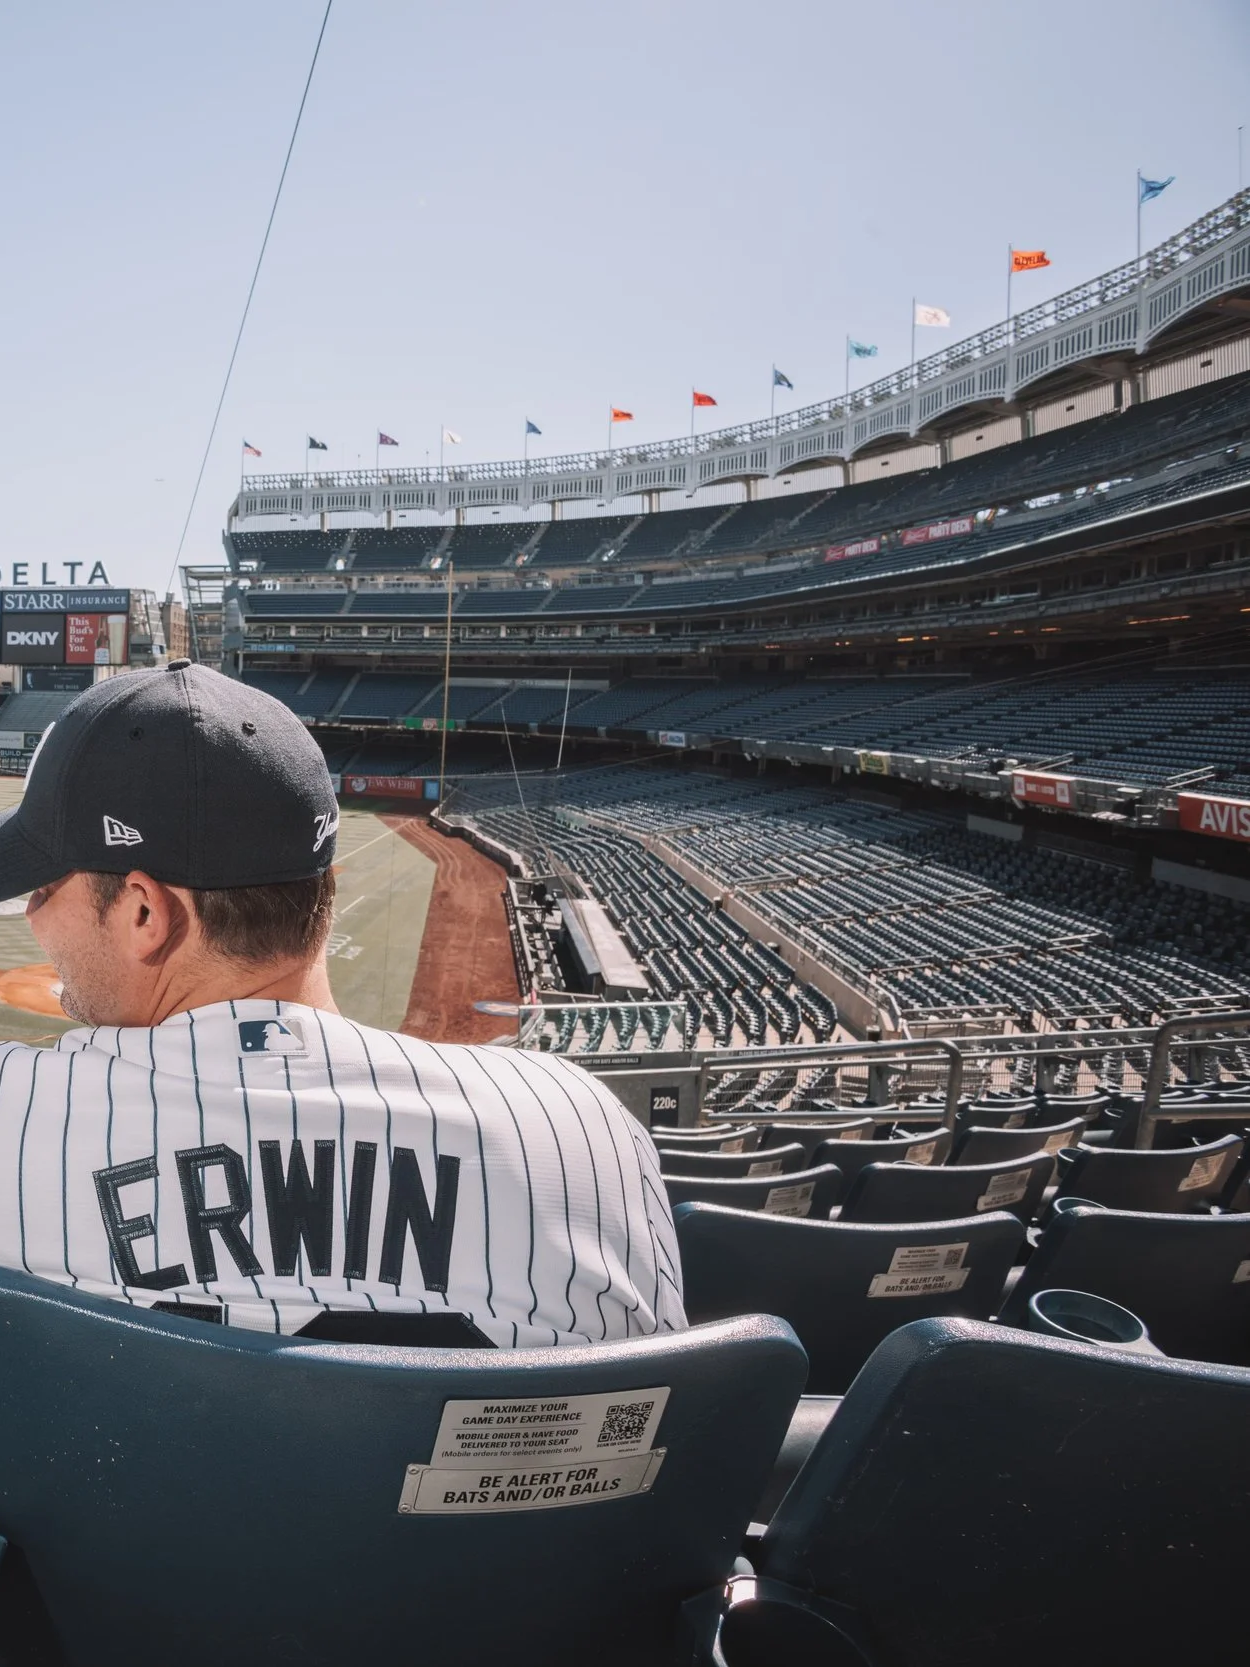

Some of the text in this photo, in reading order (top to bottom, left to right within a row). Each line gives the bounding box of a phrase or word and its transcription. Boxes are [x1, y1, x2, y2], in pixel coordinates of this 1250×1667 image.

[929, 524, 949, 539] PARTY
[951, 519, 971, 535] DECK
[4, 592, 127, 610] STARR INSURANCE
[68, 616, 90, 626] This
[69, 626, 94, 635] Bud's
[6, 631, 59, 646] DKNY
[69, 634, 85, 644] For
[68, 643, 88, 652] You.
[388, 779, 416, 790] WEBB
[1200, 802, 1250, 837] AVIS
[653, 1096, 677, 1110] 220c
[92, 1139, 461, 1294] ERWIN
[483, 1402, 568, 1414] MAXIMIZE YOUR
[462, 1412, 582, 1425] GAME DAY EXPERIENCE
[456, 1428, 579, 1440] MOBILE ORDER & HAVE FOOD
[461, 1438, 570, 1449] DELIVERED TO YOUR SEAT
[441, 1446, 583, 1459] (Mobile orders for select events only)
[479, 1468, 598, 1488] BE ALERT FOR
[443, 1491, 491, 1504] BATS
[569, 1478, 621, 1496] BALLS
